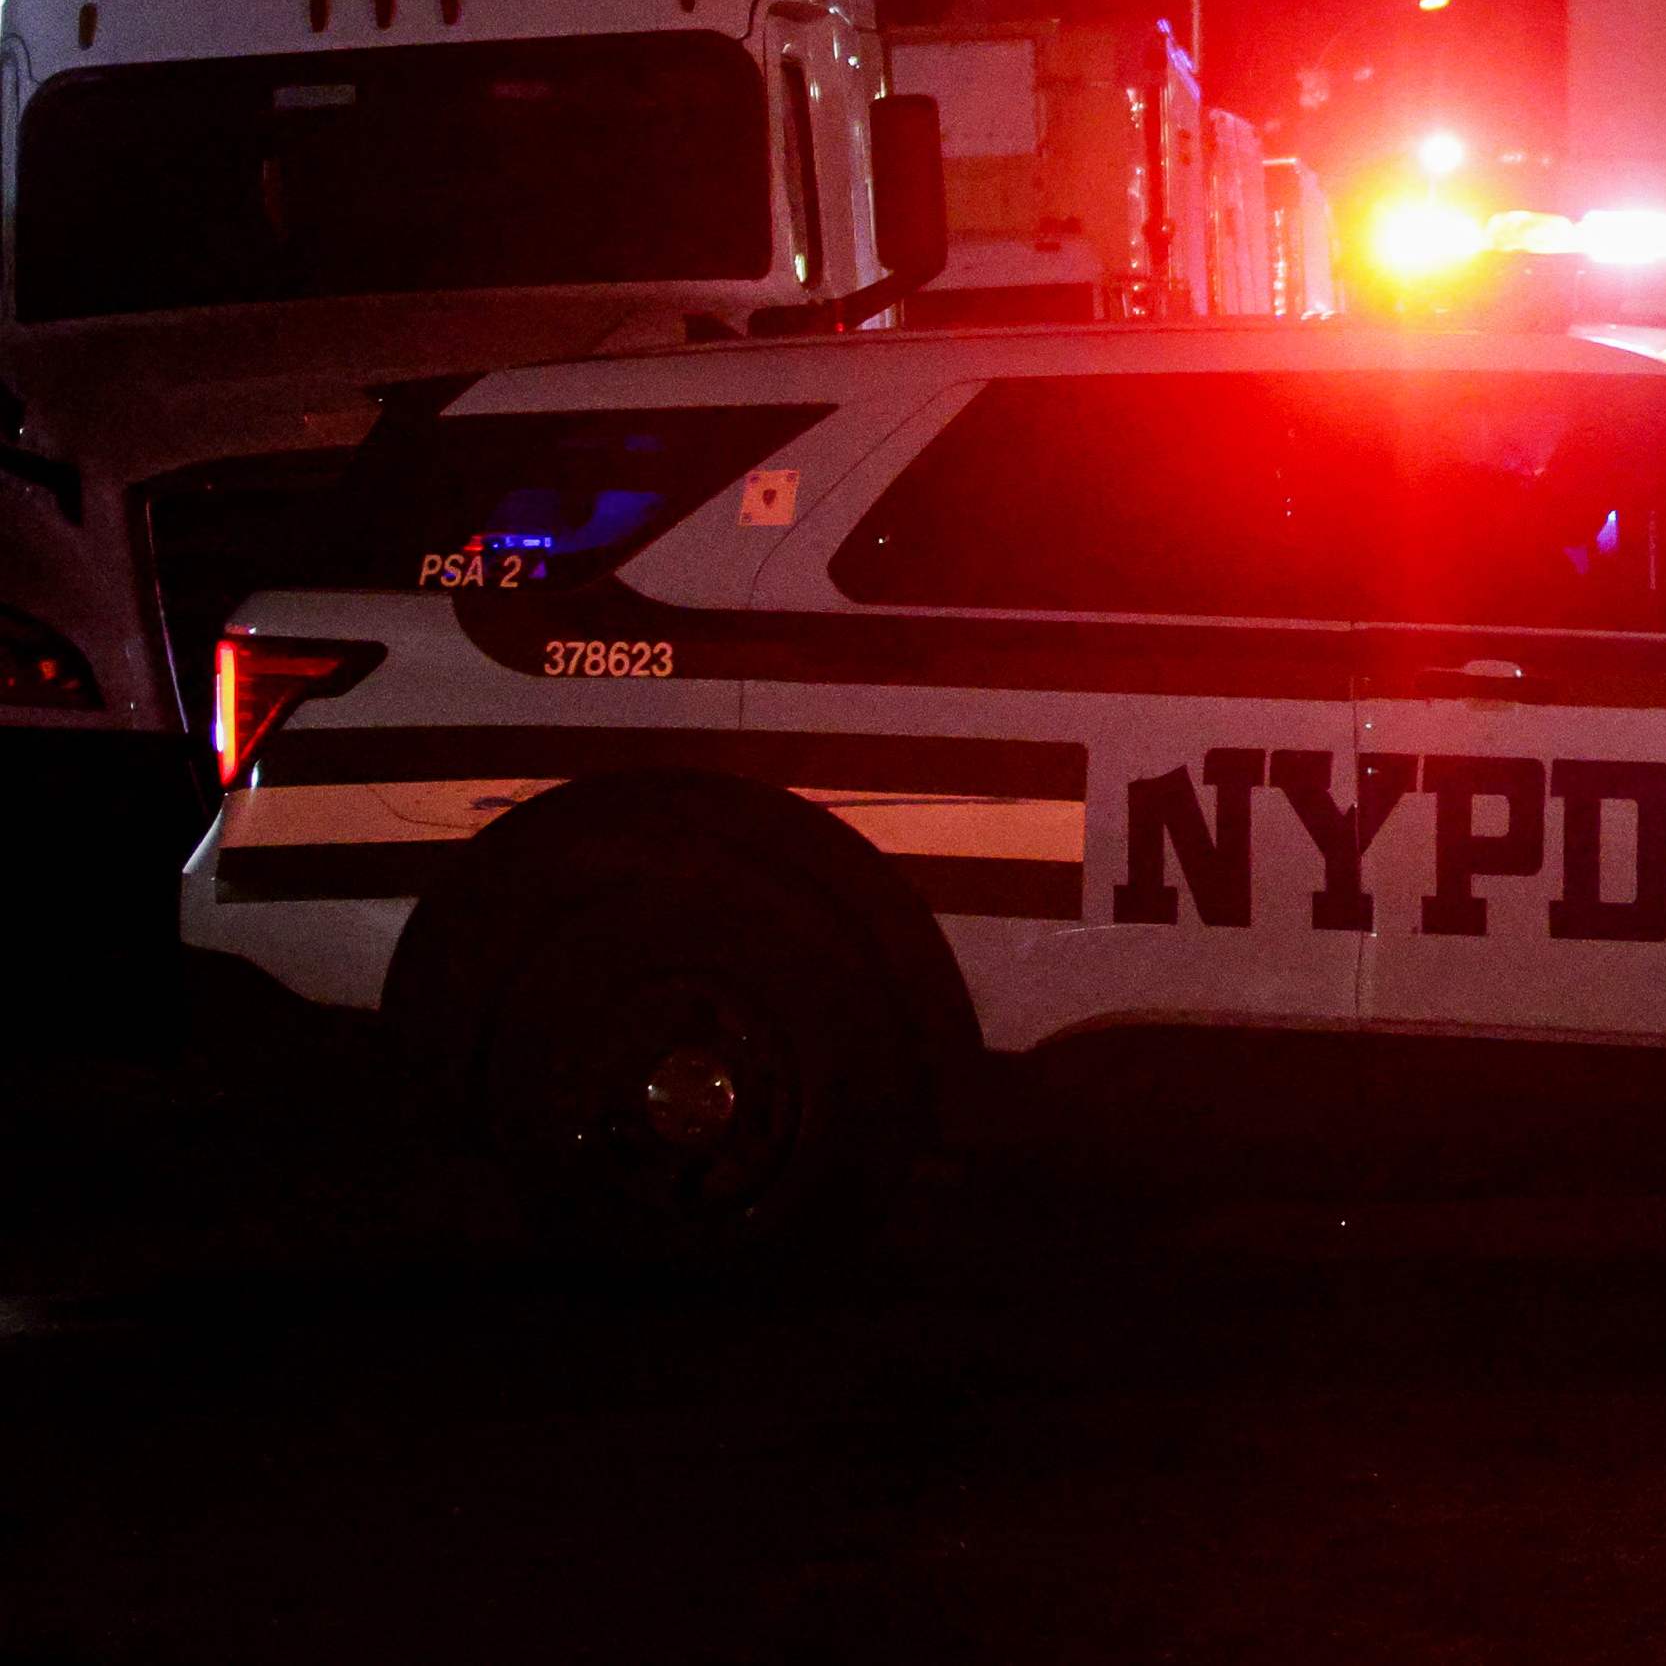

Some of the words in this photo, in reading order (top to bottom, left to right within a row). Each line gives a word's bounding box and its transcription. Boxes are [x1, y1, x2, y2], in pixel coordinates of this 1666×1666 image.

[418, 553, 485, 588] PSA
[499, 554, 523, 588] 2
[543, 640, 674, 677] 378623
